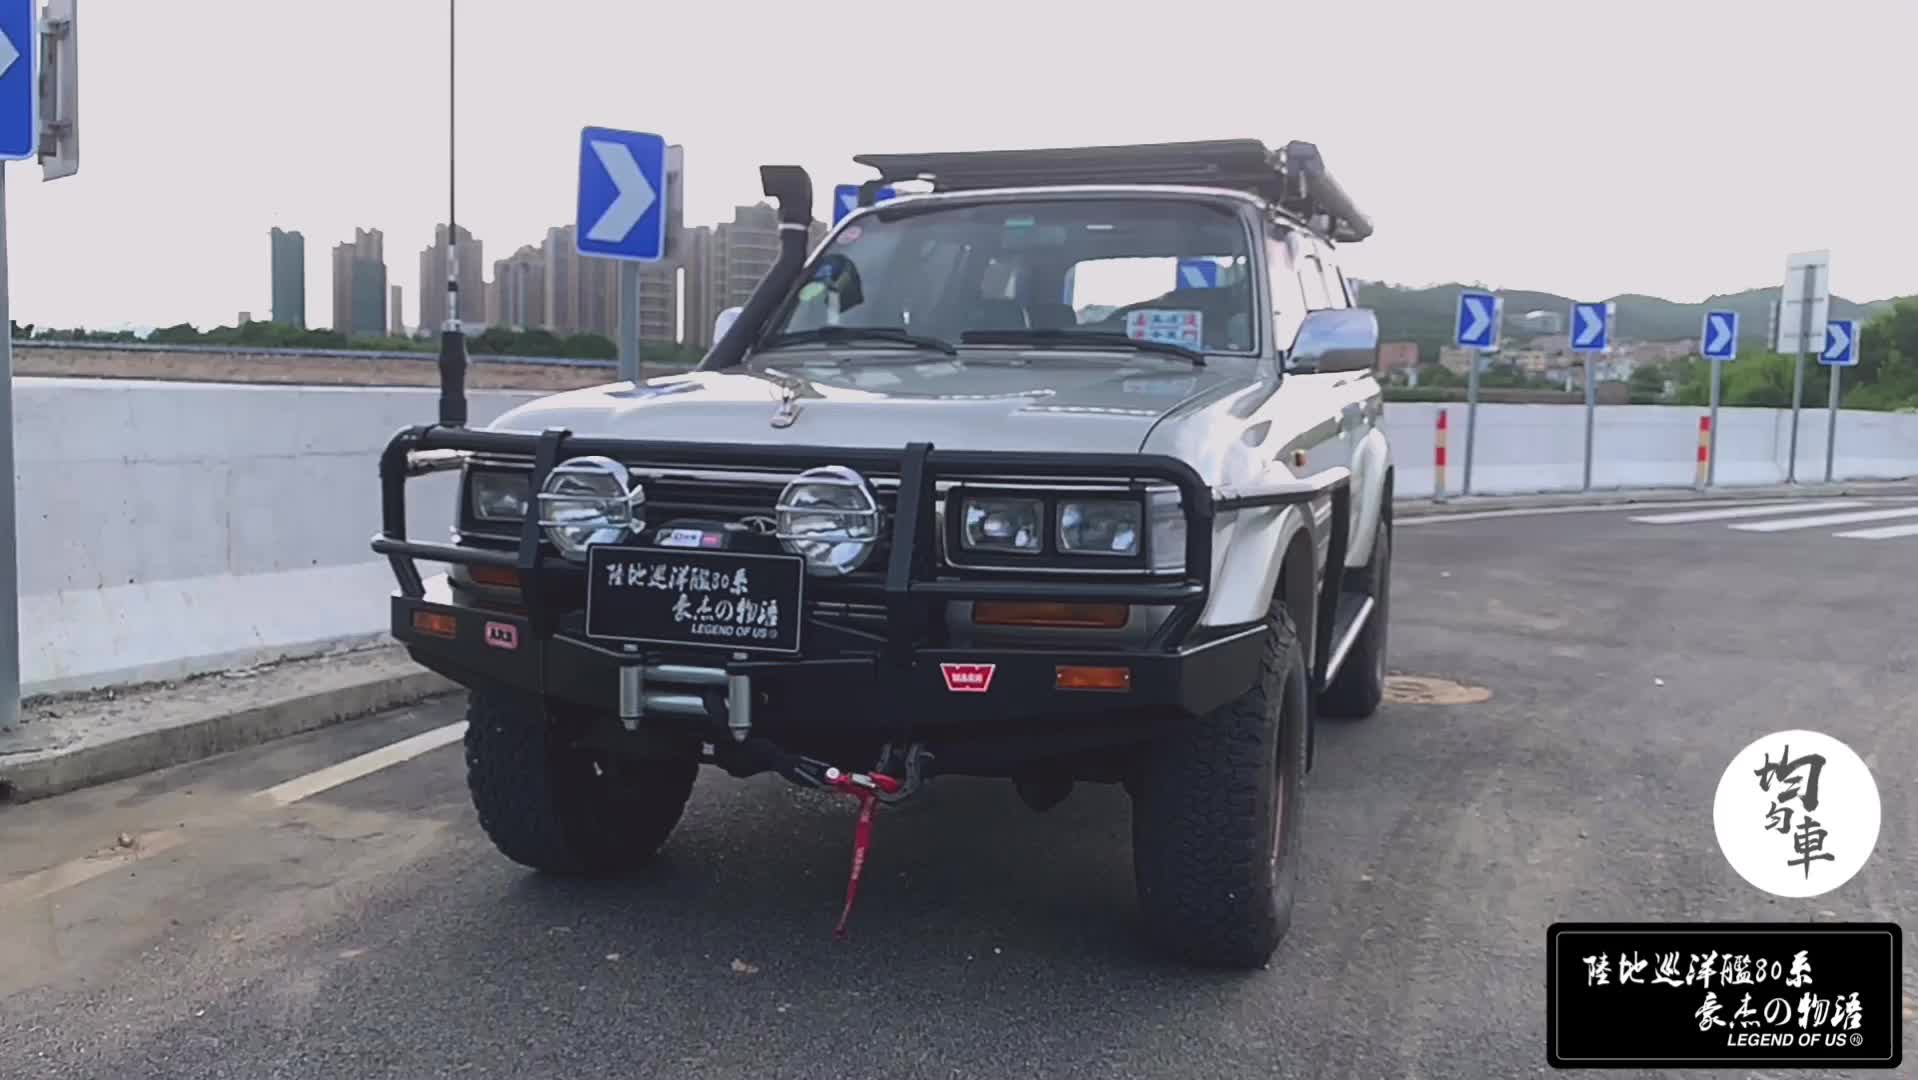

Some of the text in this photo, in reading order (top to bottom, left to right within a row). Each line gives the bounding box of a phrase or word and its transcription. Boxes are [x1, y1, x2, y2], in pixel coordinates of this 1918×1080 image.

[691, 624, 733, 636] LEGEND
[735, 625, 751, 638] OF
[752, 627, 768, 639] US
